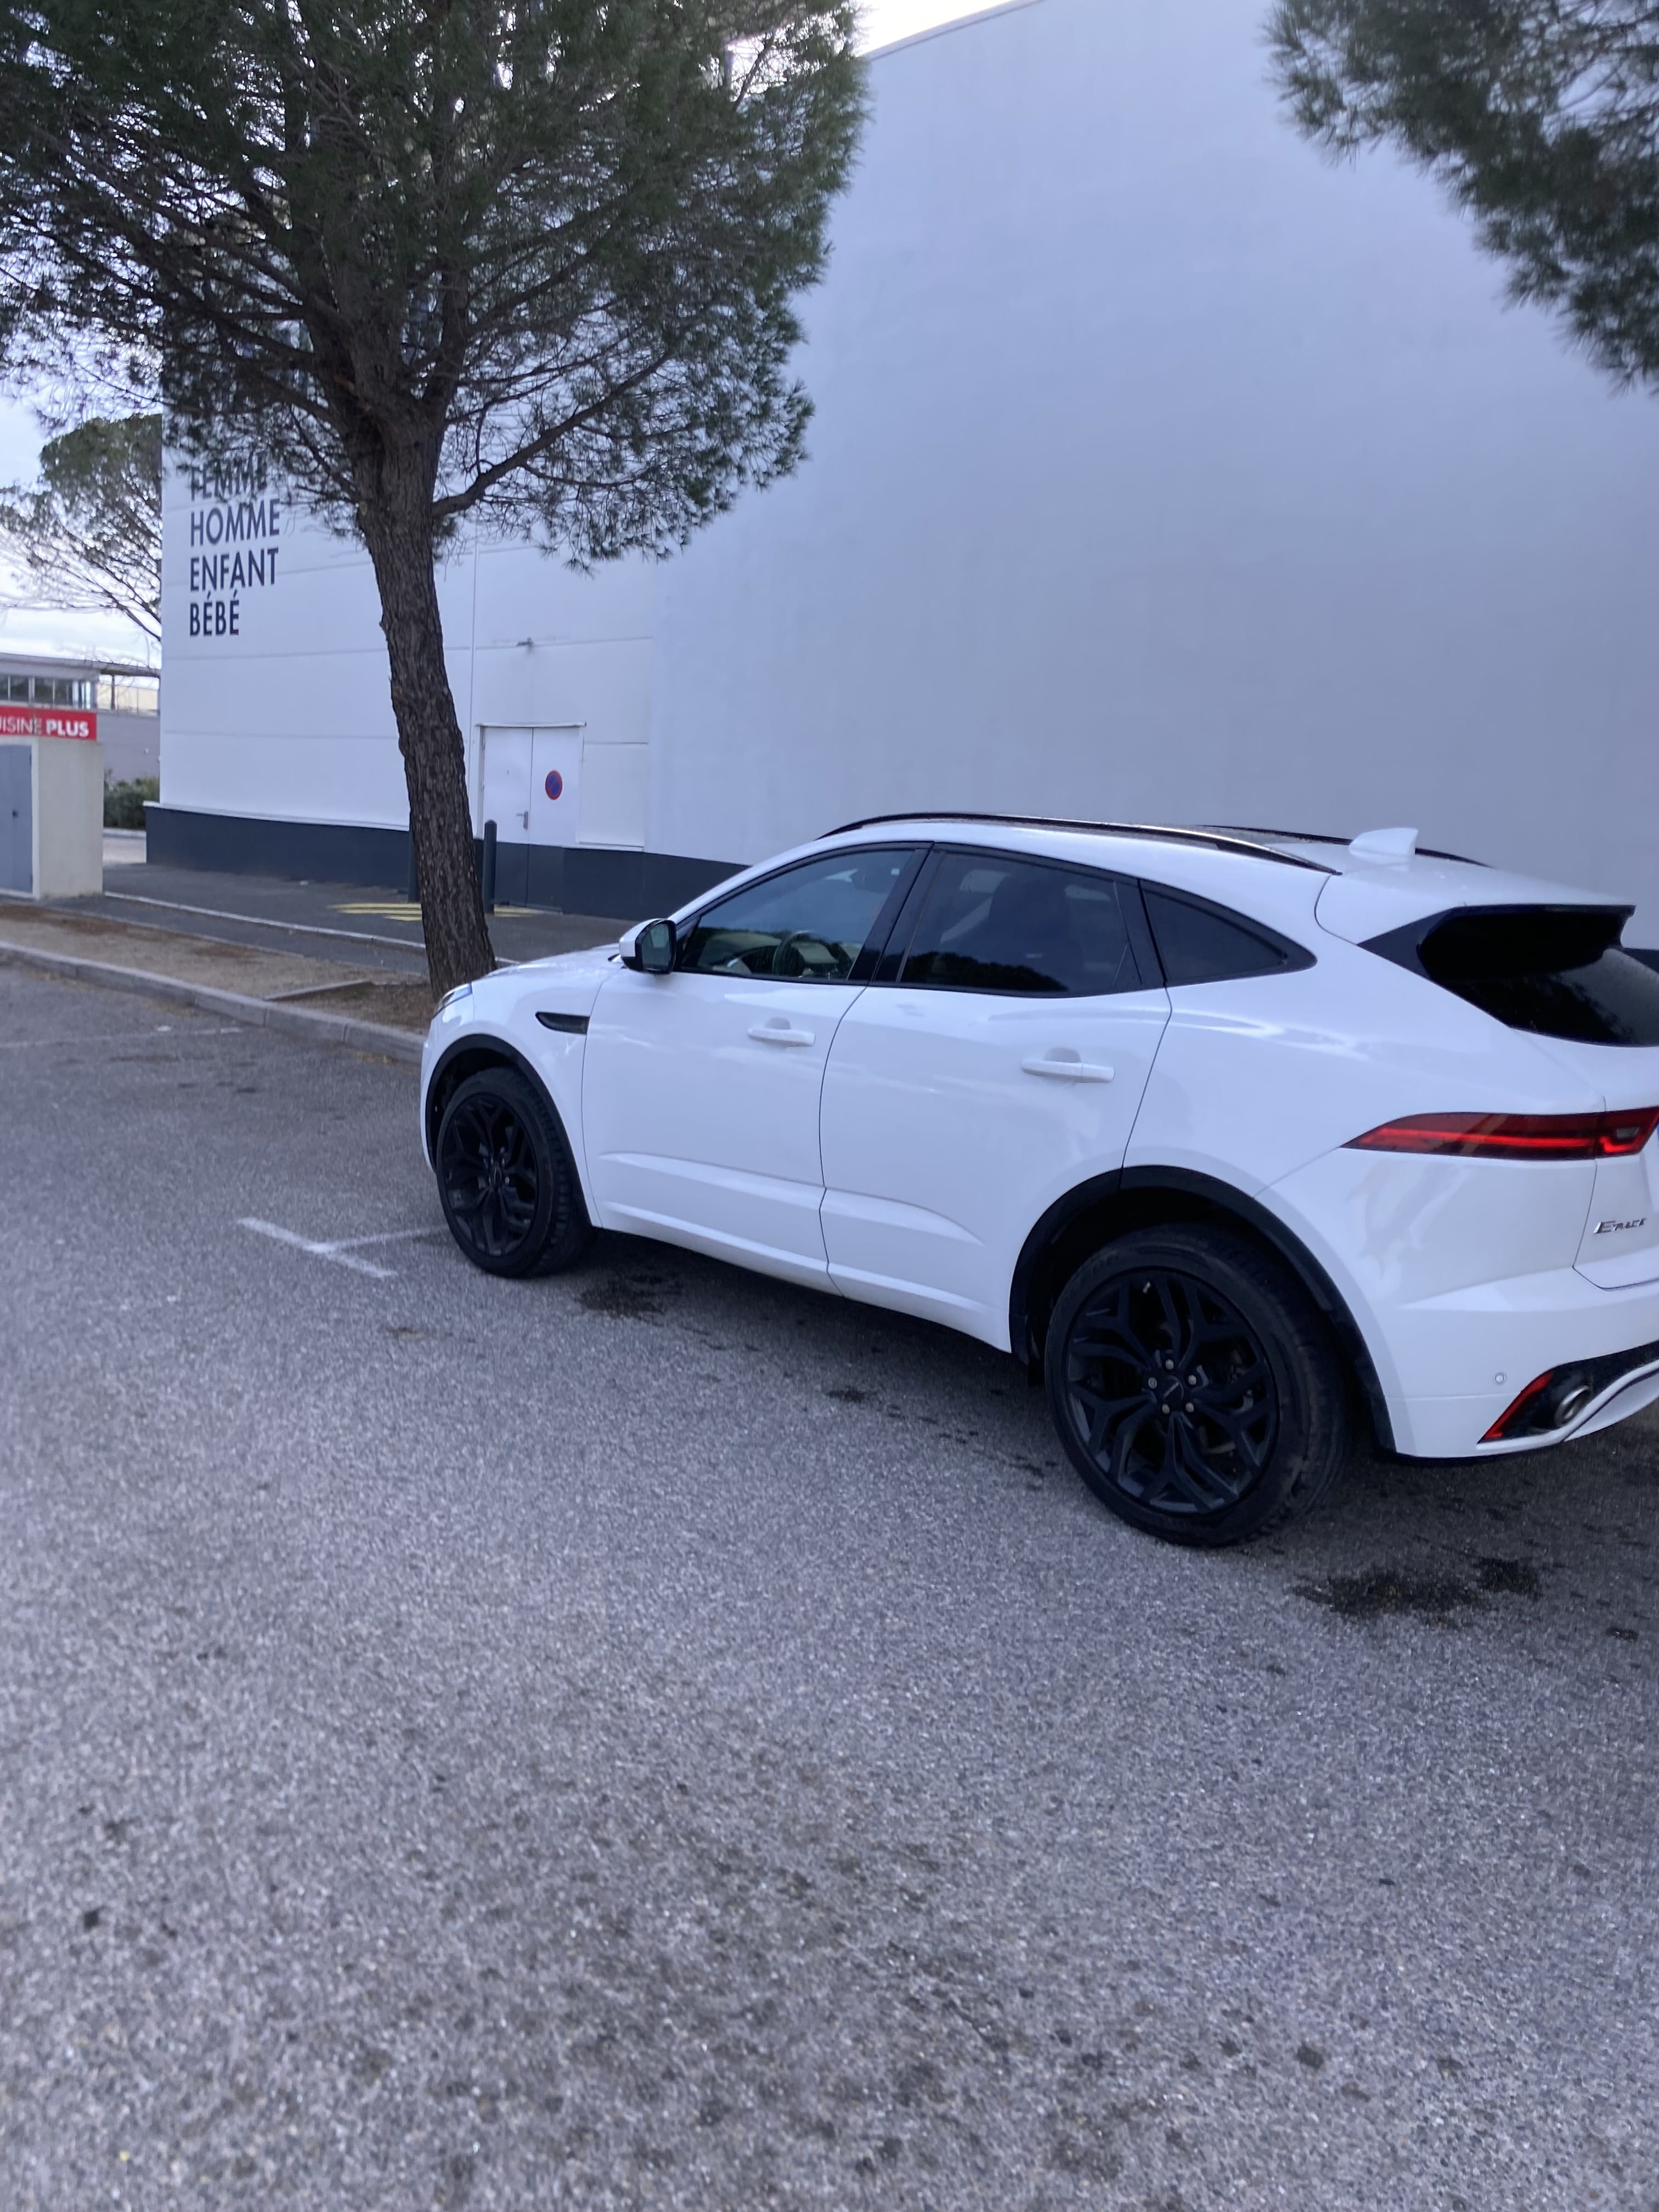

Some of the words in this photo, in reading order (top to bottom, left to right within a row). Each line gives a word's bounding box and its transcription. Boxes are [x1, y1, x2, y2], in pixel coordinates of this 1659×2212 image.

[190, 499, 280, 547] HOMME
[190, 548, 279, 592] ENFANT
[189, 590, 239, 636] BÉBÉ
[46, 719, 89, 737] PLUS
